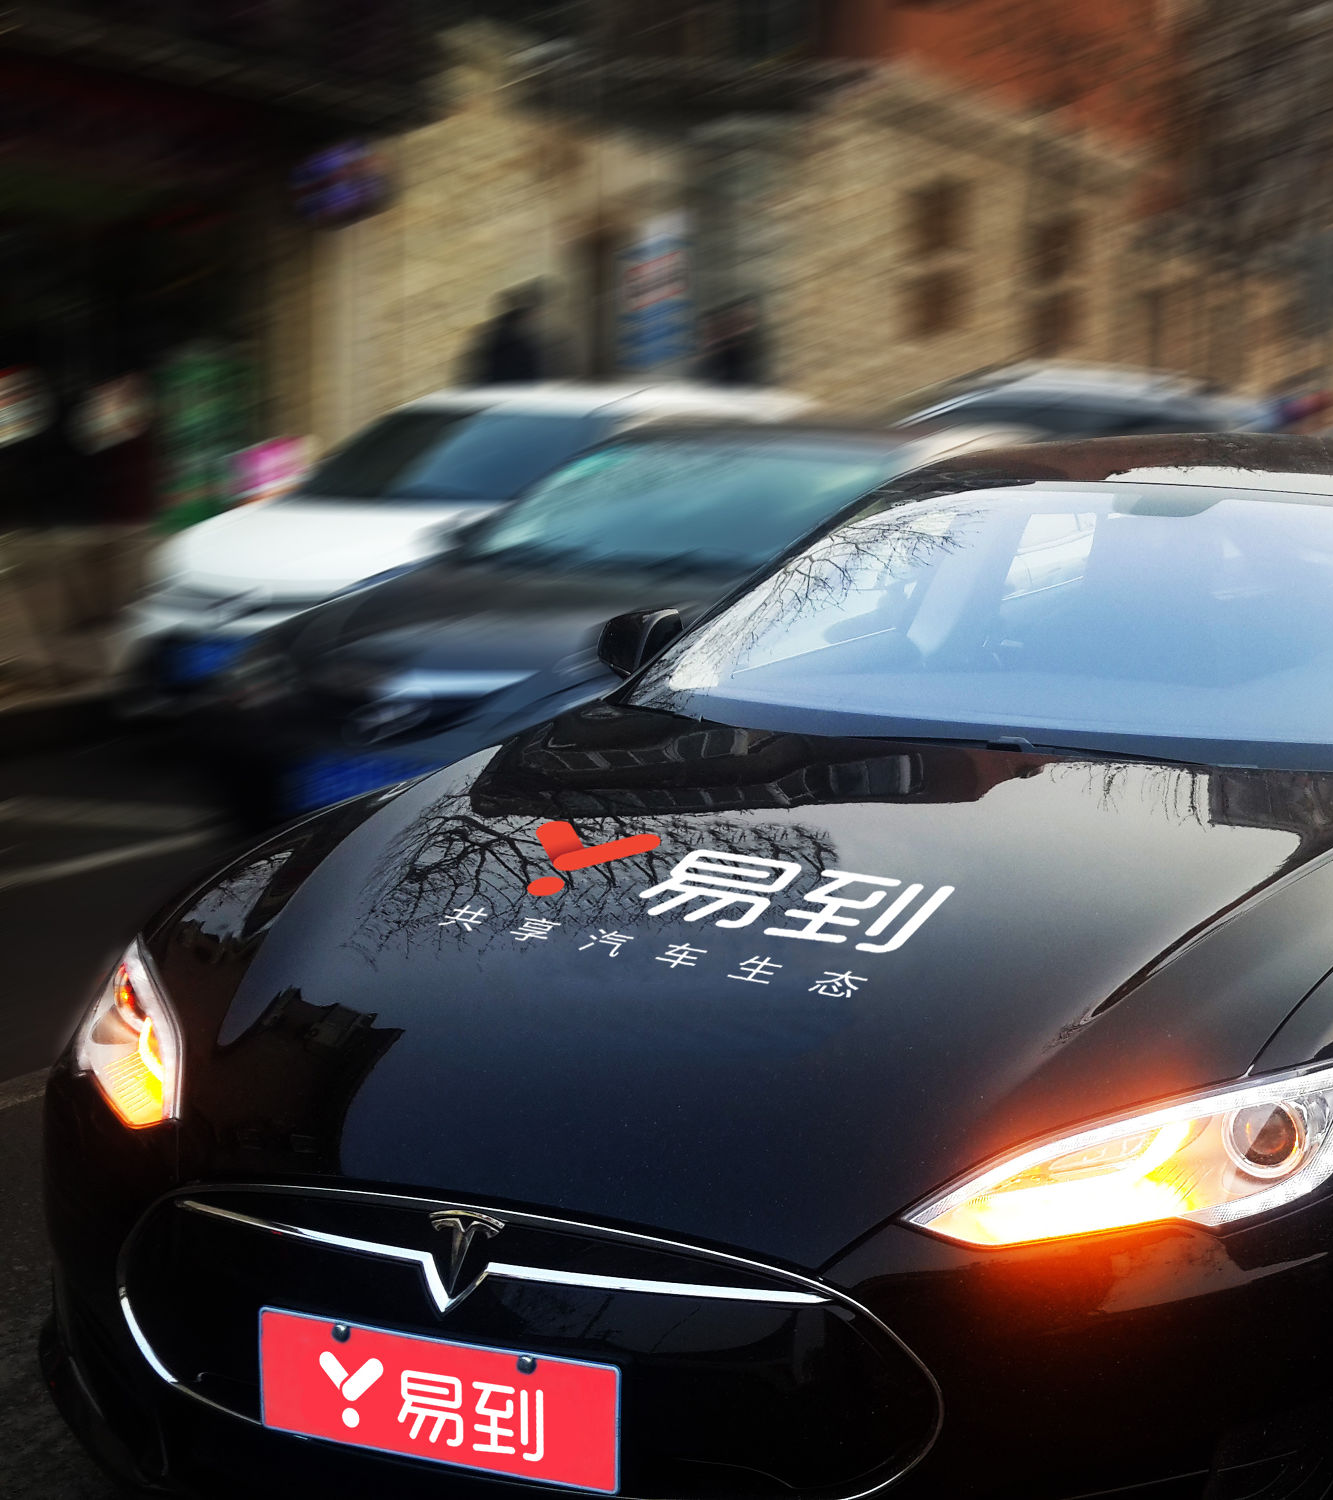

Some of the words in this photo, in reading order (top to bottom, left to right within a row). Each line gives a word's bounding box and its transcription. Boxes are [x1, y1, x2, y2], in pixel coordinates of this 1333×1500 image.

[638, 848, 956, 953] 易到
[437, 904, 869, 999] 共享汽车生态
[396, 1369, 545, 1462] 易到
